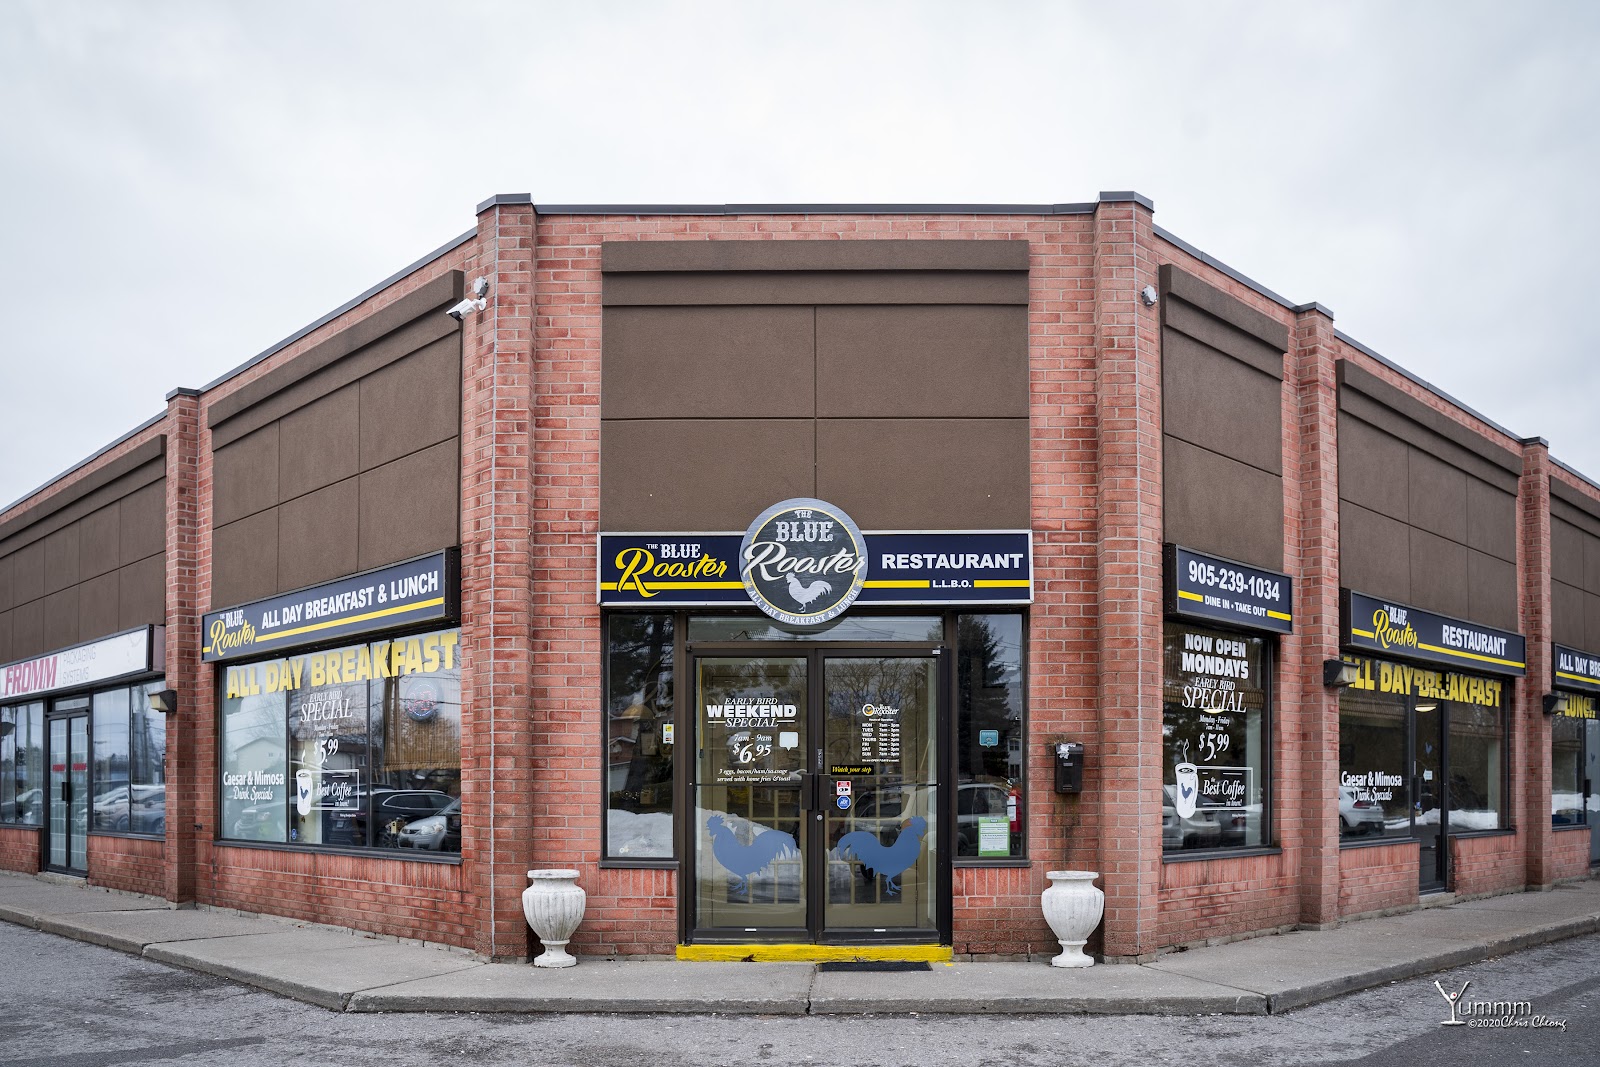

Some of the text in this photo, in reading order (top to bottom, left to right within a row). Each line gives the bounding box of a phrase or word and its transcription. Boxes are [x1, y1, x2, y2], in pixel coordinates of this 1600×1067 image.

[794, 510, 812, 518] THE
[776, 521, 834, 542] BLUE
[660, 544, 701, 558] BLUE
[742, 542, 865, 581] Rooster
[882, 554, 1024, 569] RESTAURANT
[615, 548, 728, 598] Rooster
[1188, 560, 1280, 602] 905-239-1034
[932, 580, 972, 588] L.L.B.O.
[262, 570, 438, 630] ALL DAY BREAKFAST & LUNCH
[748, 590, 763, 606] ALL
[763, 604, 778, 617] DAY
[779, 612, 826, 624] BREAKFAST
[837, 589, 858, 613] LUNCH
[1205, 595, 1266, 617] DINE IN TAKE OUT
[226, 610, 244, 628] BLUE
[1390, 606, 1408, 626] BLUE
[210, 619, 256, 656] Rooster
[1373, 610, 1418, 649] Rooster
[1442, 624, 1506, 656] RESTAURANT
[1185, 633, 1246, 658] NOW OPEN
[4, 646, 96, 696] FROMM PACKAGING
[227, 632, 458, 699] ALL DAY BREAKFAST
[1182, 652, 1249, 679] MONDAYS
[1560, 653, 1574, 672] ALL
[1575, 656, 1588, 674] DAY
[62, 666, 89, 685] SYSTEMS
[1195, 676, 1236, 691] EARLY BIRD
[1344, 656, 1375, 690] LL
[1380, 662, 1415, 696] DAY
[310, 692, 328, 702] EARLY
[1182, 685, 1246, 713] SPECIAL
[300, 698, 353, 722] SPECIAL
[706, 704, 796, 718] WEEKEND
[725, 718, 780, 728] SPECIAL
[734, 734, 750, 742] 7am
[756, 734, 772, 742] 9am
[1198, 732, 1230, 762] $5.99
[314, 738, 338, 765] $5.99
[732, 743, 772, 764] $6.95
[223, 770, 284, 785] Caesar & Mimosa
[1341, 771, 1402, 786] Caesar & Mimosa
[316, 782, 352, 800] Best Coffee
[1203, 780, 1245, 800] Best Coffee
